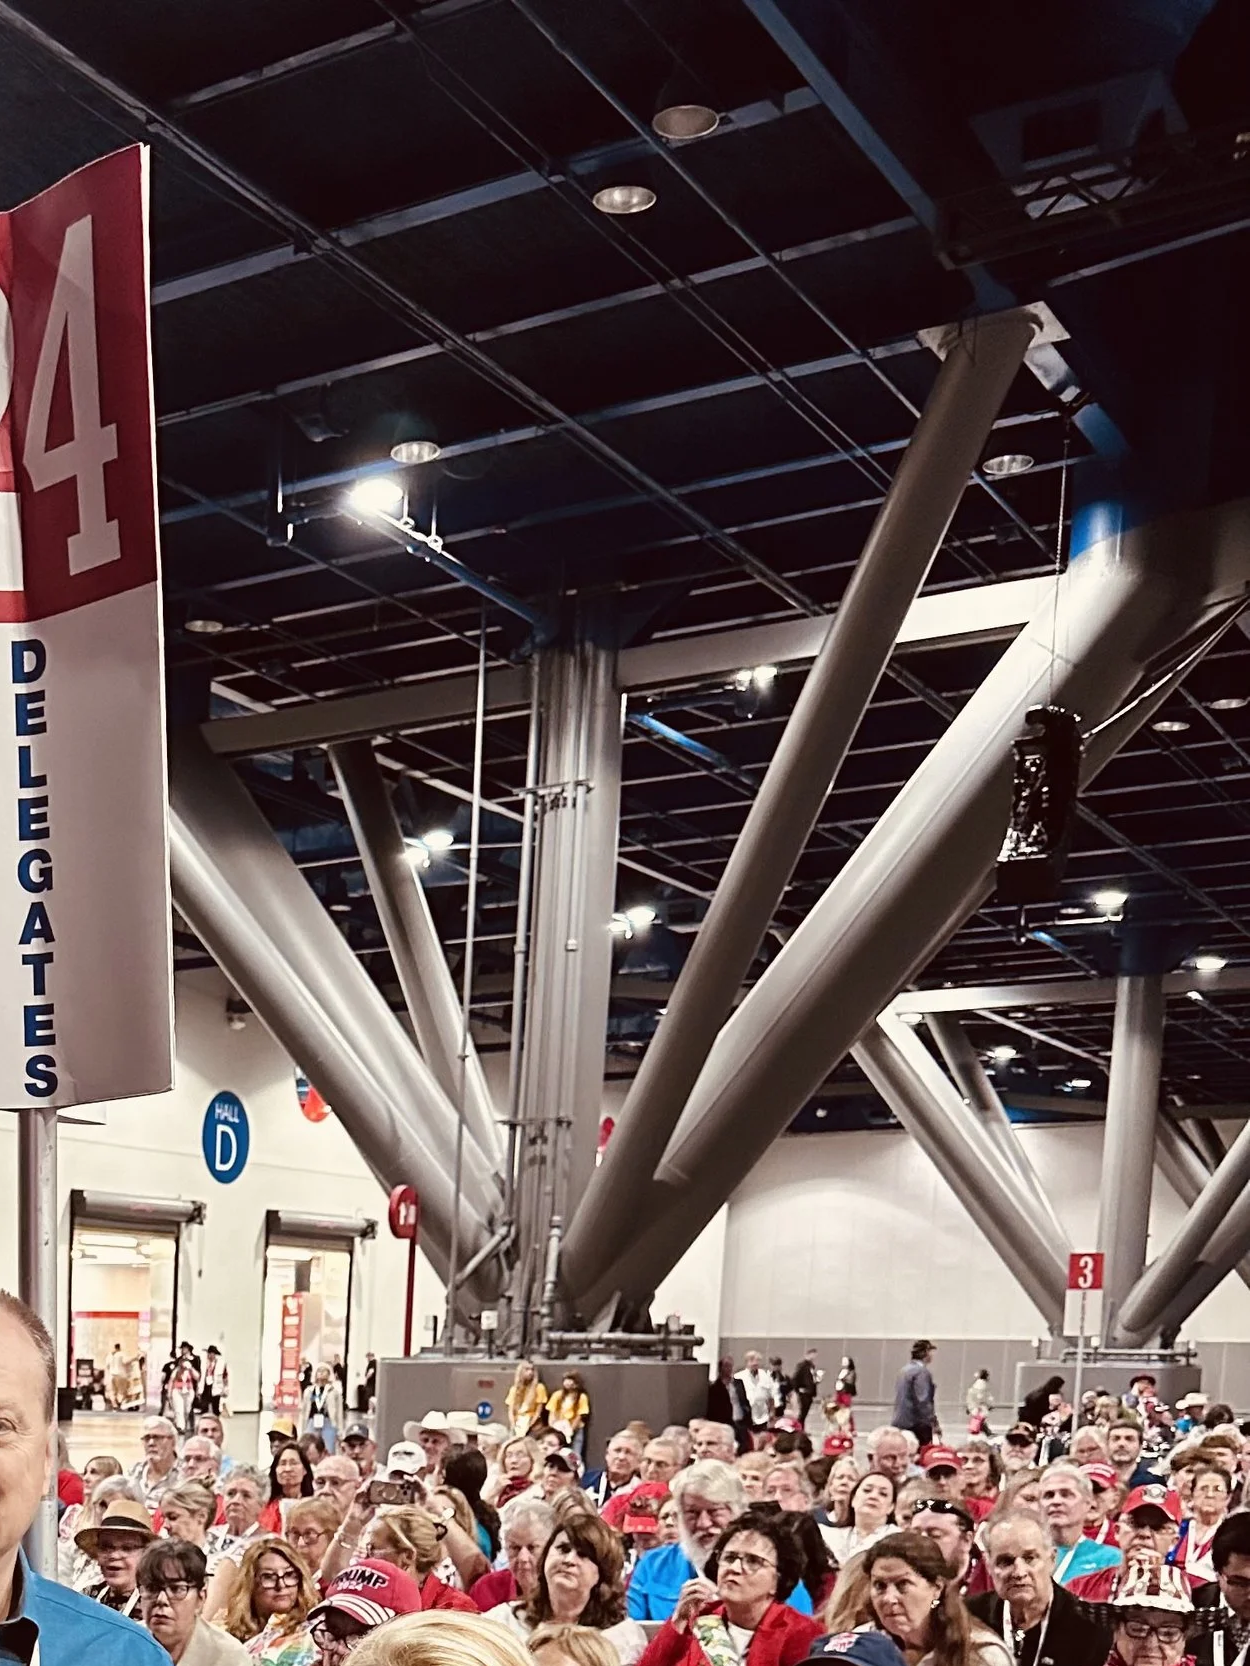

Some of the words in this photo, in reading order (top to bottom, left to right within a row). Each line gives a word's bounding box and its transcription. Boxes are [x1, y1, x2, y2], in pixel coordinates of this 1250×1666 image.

[9, 638, 60, 1099] DELEGATES
[214, 1102, 240, 1123] HALL
[215, 1124, 238, 1171] D
[1077, 1256, 1094, 1289] 3
